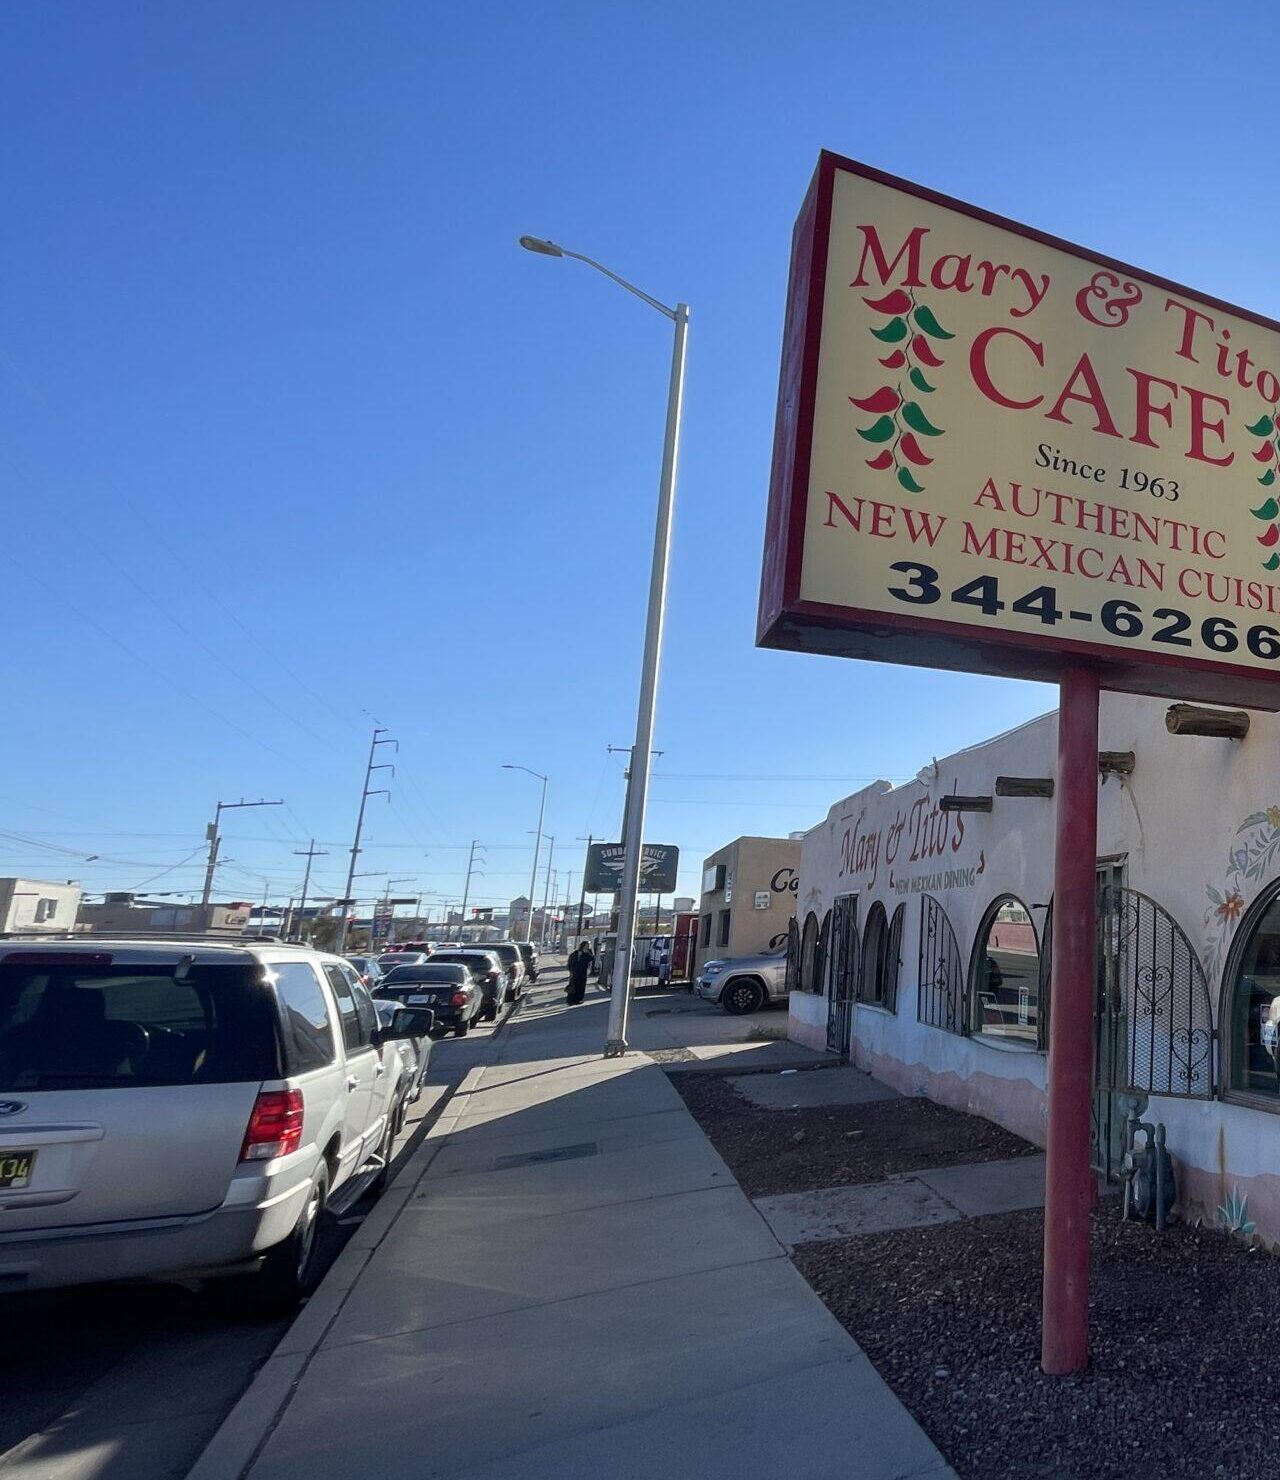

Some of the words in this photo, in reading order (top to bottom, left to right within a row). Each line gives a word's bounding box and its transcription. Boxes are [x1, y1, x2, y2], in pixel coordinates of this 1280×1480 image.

[850, 225, 1050, 317] Mary
[1076, 271, 1142, 328] &
[969, 327, 1235, 467] CAFE
[1035, 443, 1106, 483] Since
[1119, 466, 1181, 502] 1963
[823, 493, 948, 547] NEW
[961, 521, 1166, 592] MEXICAN
[974, 478, 1227, 559] AUTHENTIC
[839, 808, 882, 891] Mary
[895, 879, 909, 895] NEW
[911, 872, 942, 893] MEXICAN
[944, 867, 975, 890] DINING
